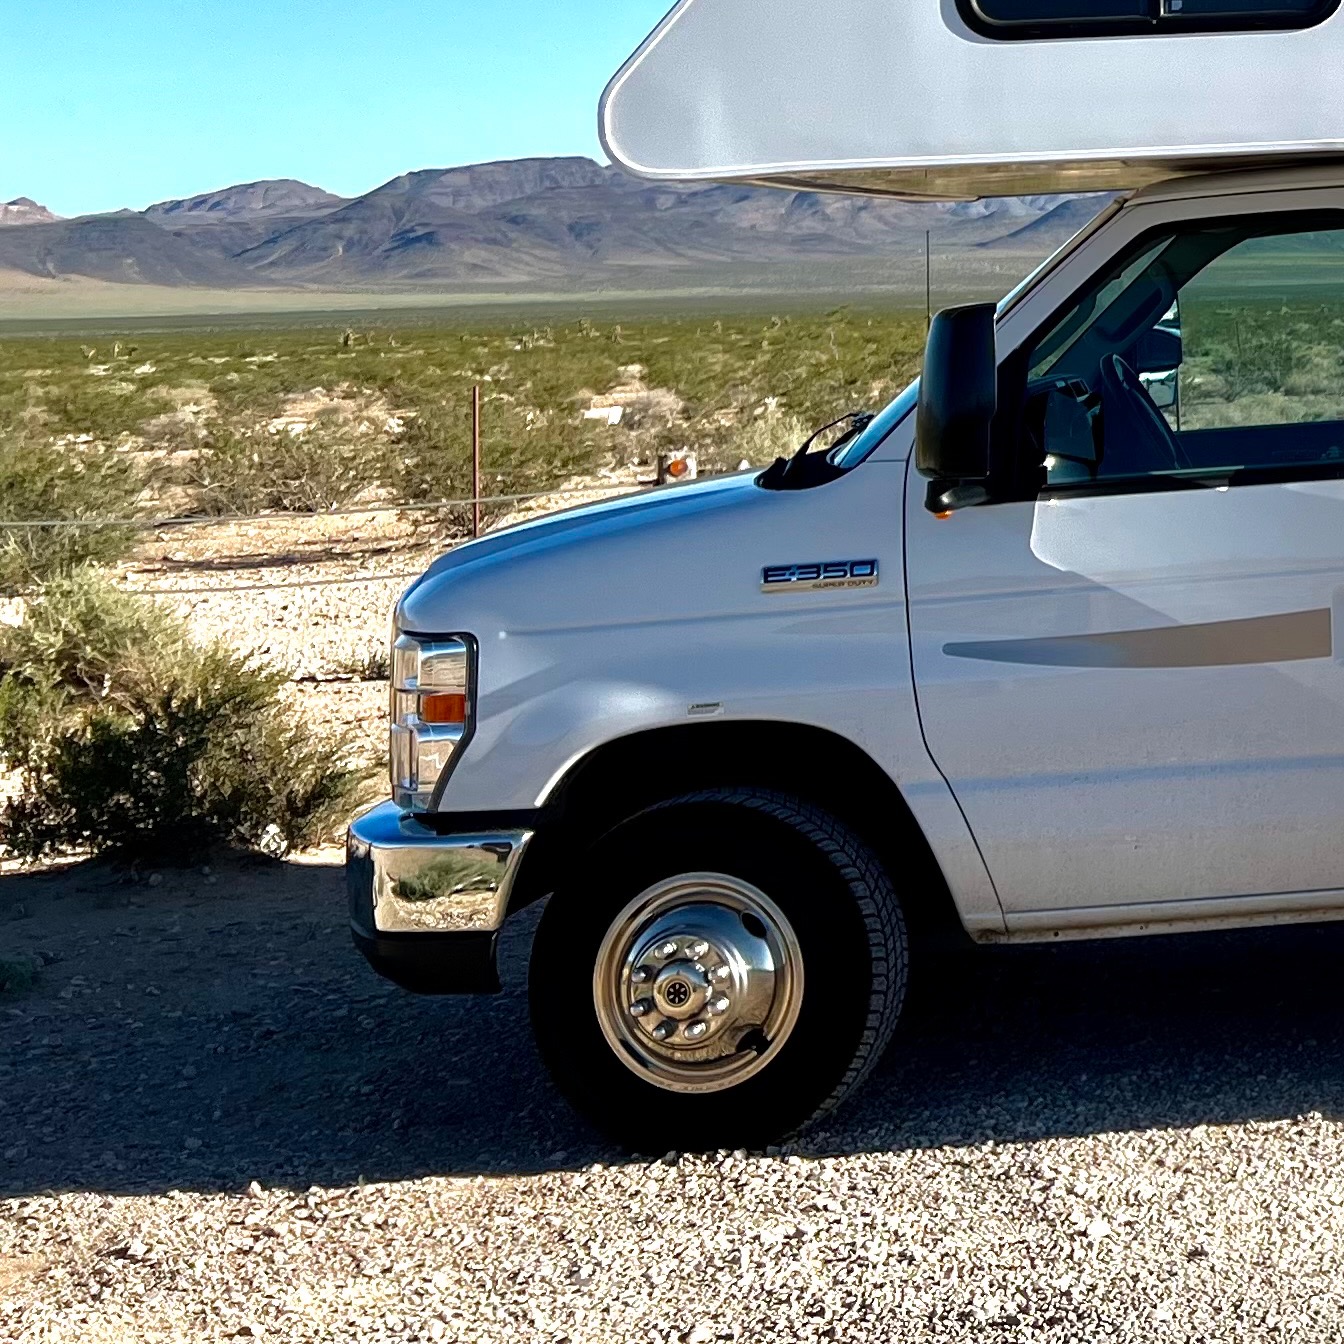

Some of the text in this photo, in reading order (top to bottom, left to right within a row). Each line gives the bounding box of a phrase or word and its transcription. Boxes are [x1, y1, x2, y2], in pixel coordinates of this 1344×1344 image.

[764, 560, 876, 583] E-350
[812, 579, 875, 589] SUPER DUTY
